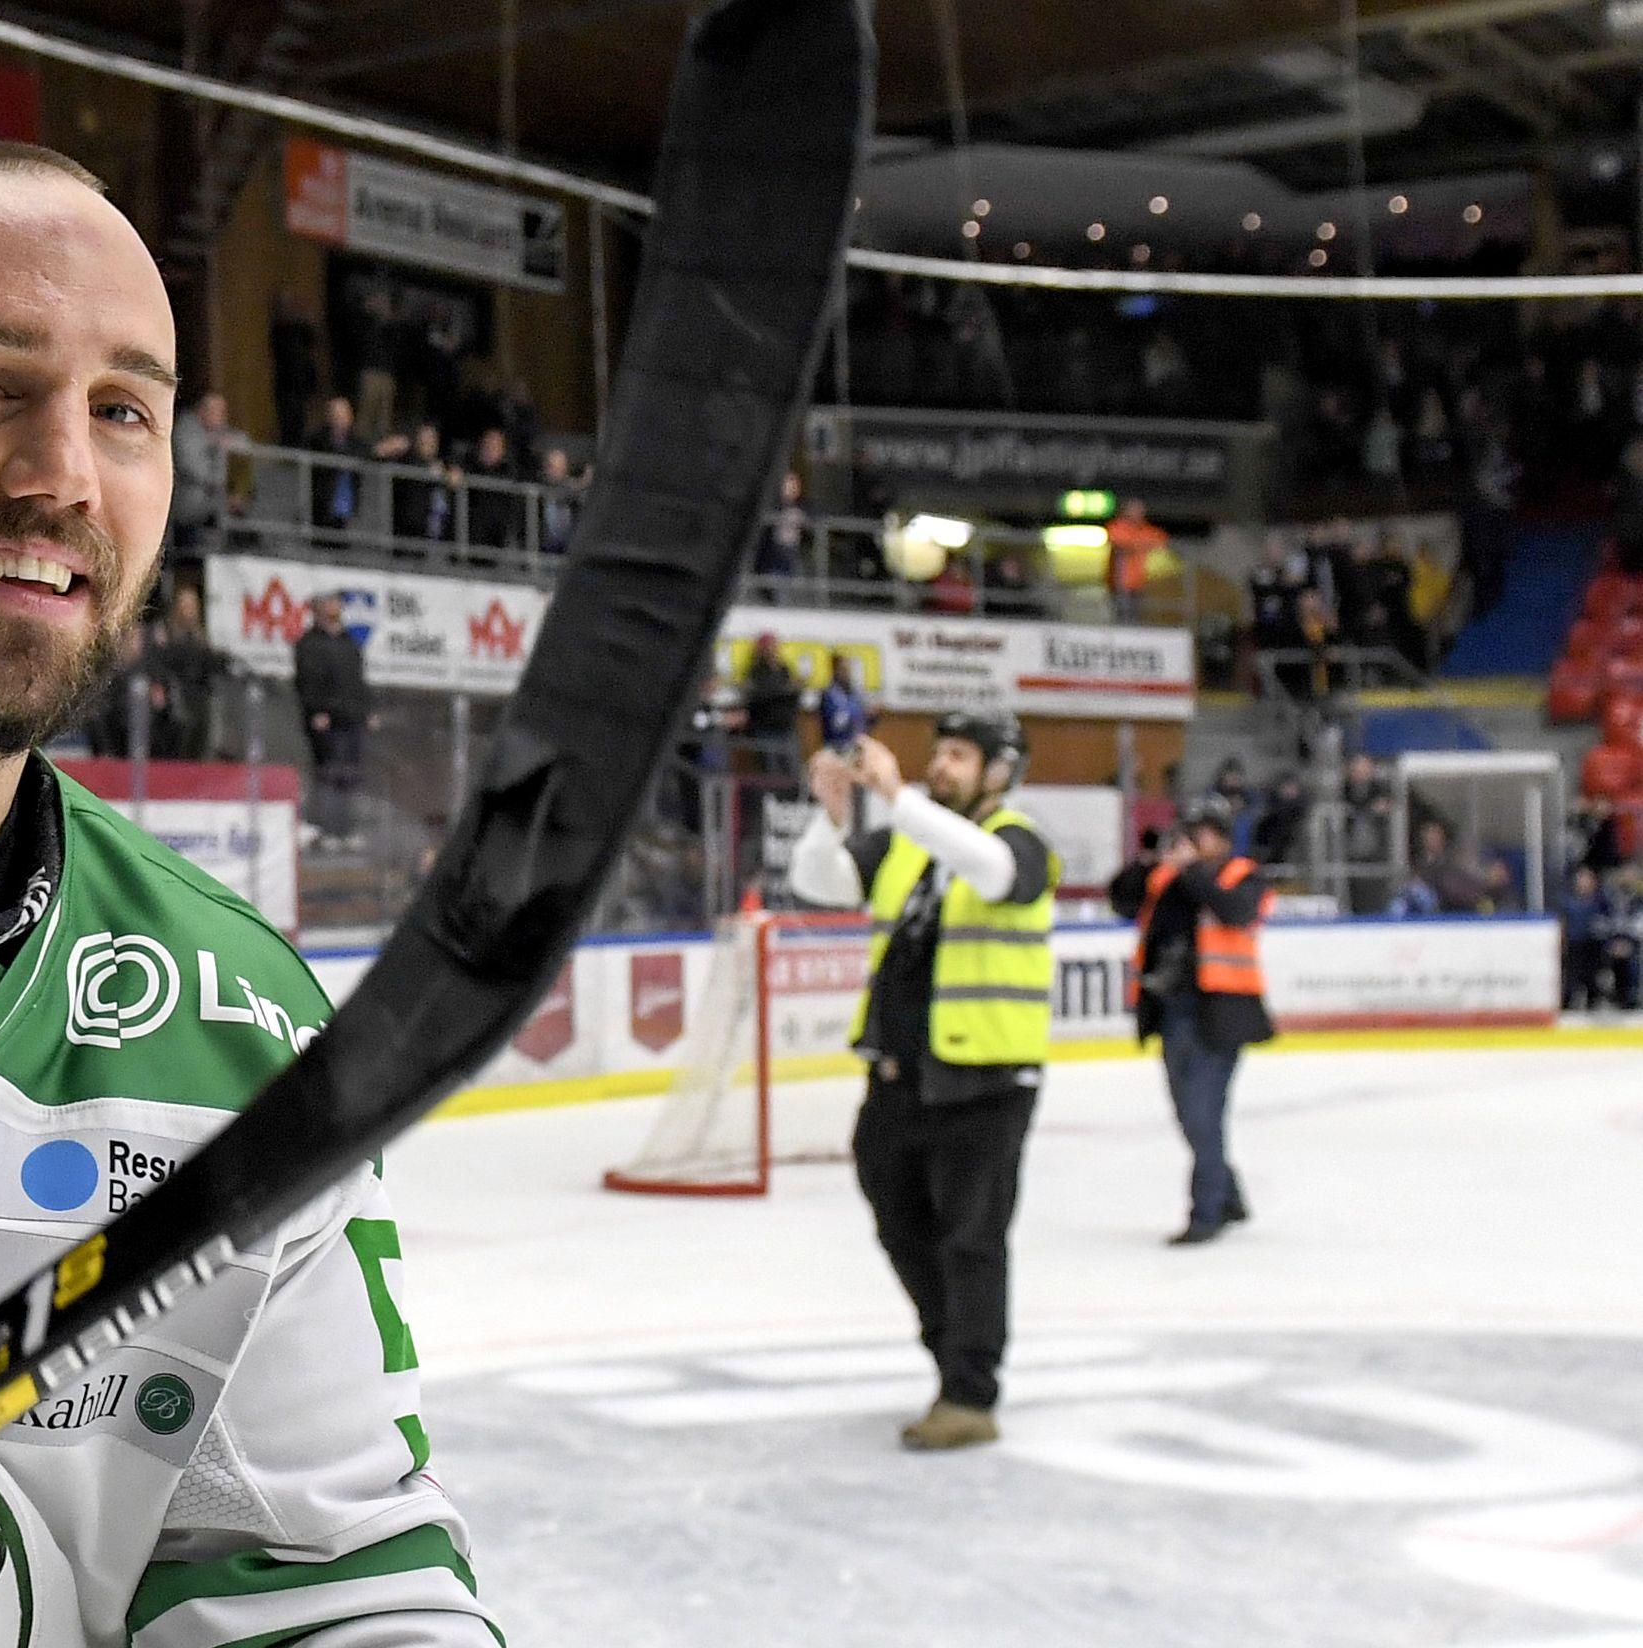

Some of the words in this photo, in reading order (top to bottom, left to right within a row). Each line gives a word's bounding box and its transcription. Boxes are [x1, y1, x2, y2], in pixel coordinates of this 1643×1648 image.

[196, 949, 327, 1057] Lin
[108, 1178, 145, 1214] Ba
[109, 1139, 178, 1184] Res
[37, 1233, 235, 1392] BAUER
